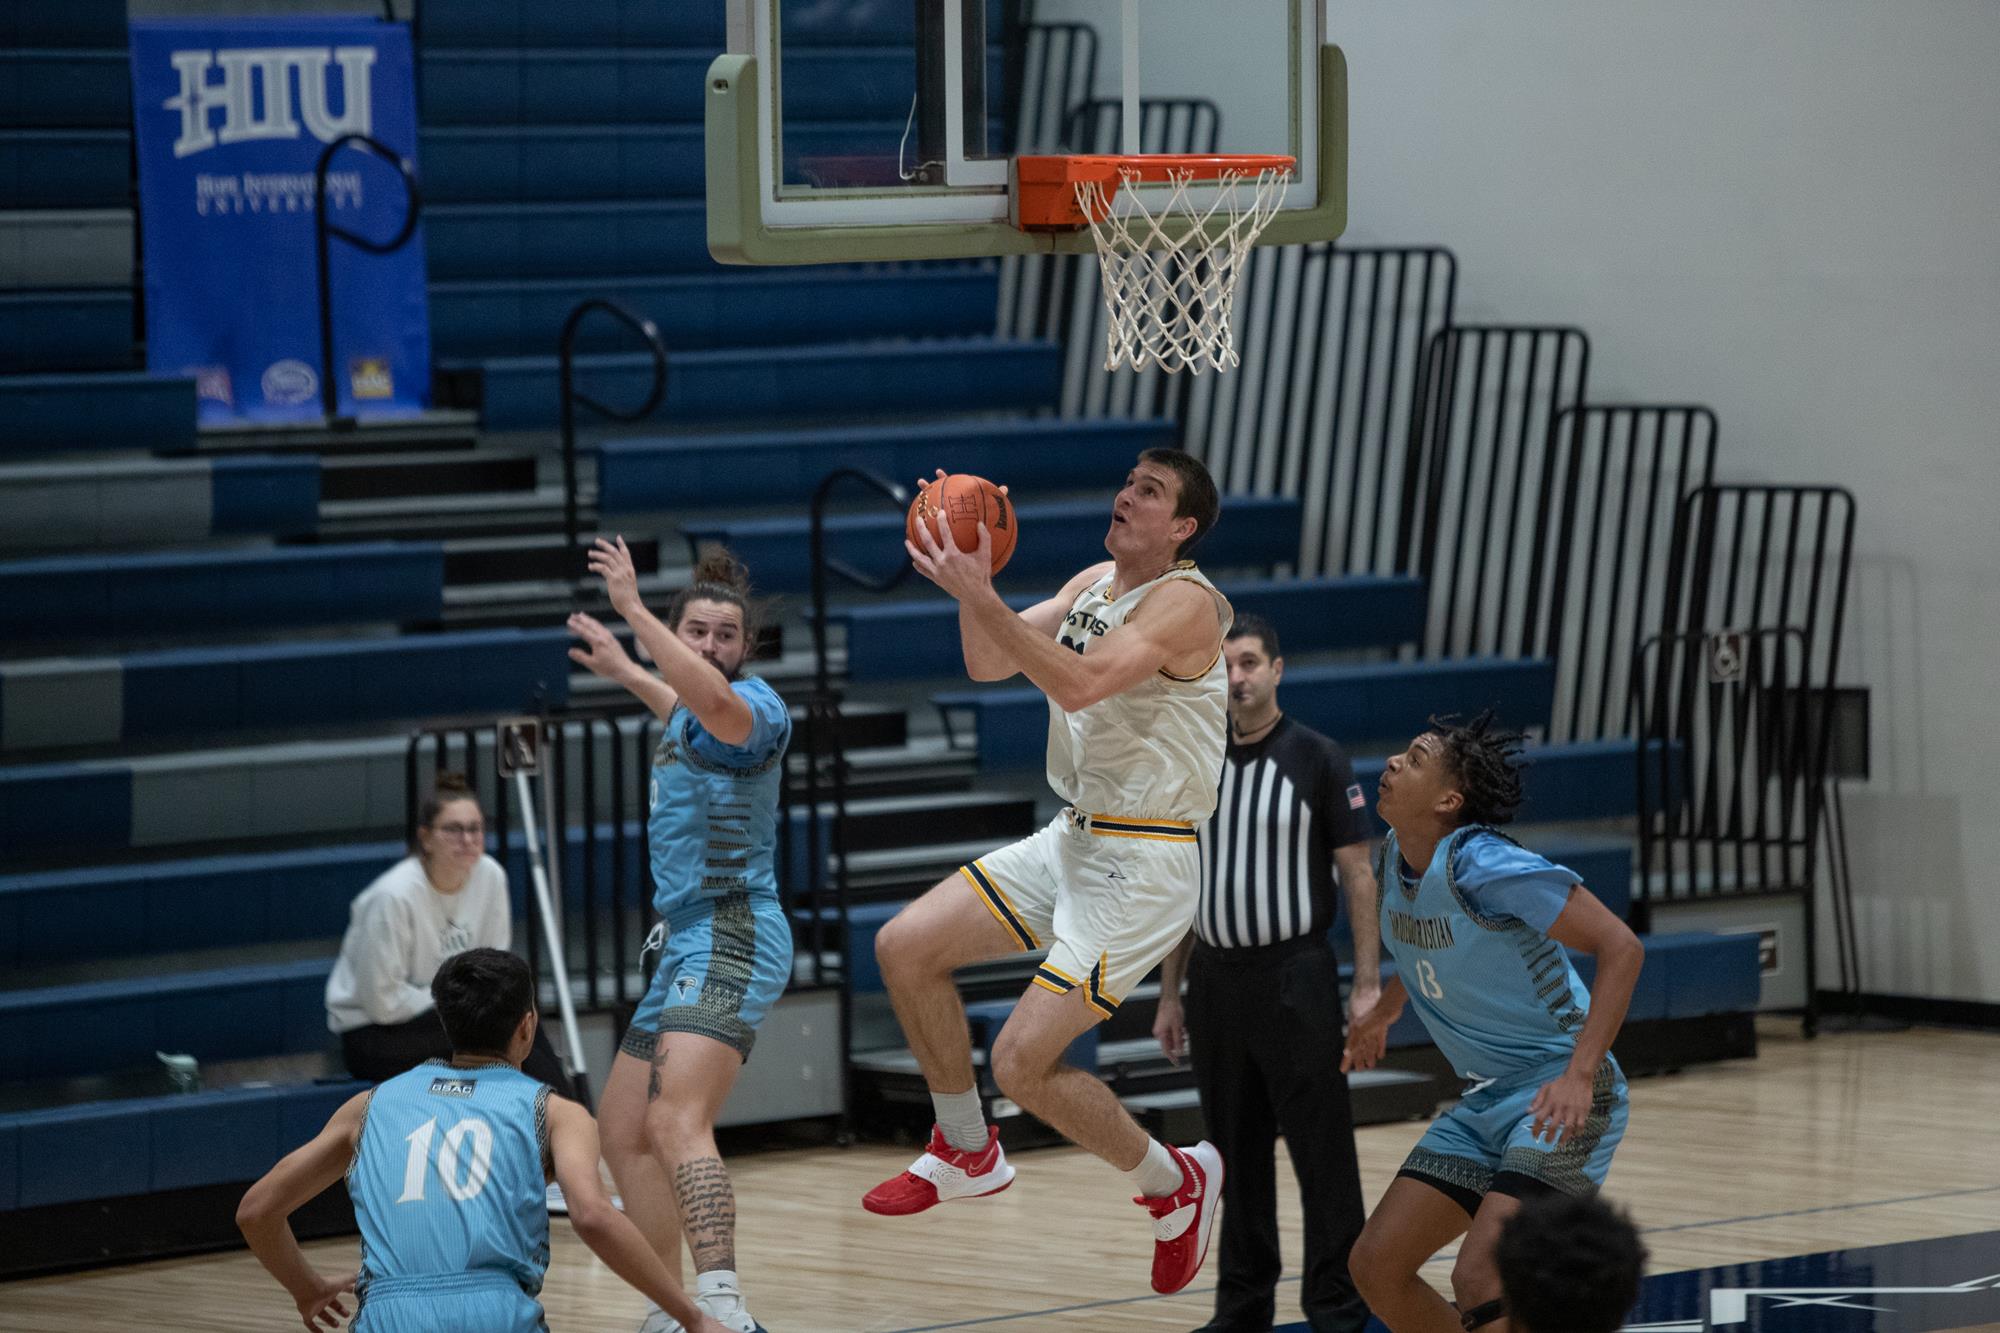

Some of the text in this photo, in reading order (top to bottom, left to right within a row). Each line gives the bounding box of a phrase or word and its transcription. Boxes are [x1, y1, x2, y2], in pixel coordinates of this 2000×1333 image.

[164, 46, 377, 158] HIU
[1416, 959, 1443, 999] 13
[431, 1083, 473, 1095] GSAC
[396, 1115, 493, 1204] 10
